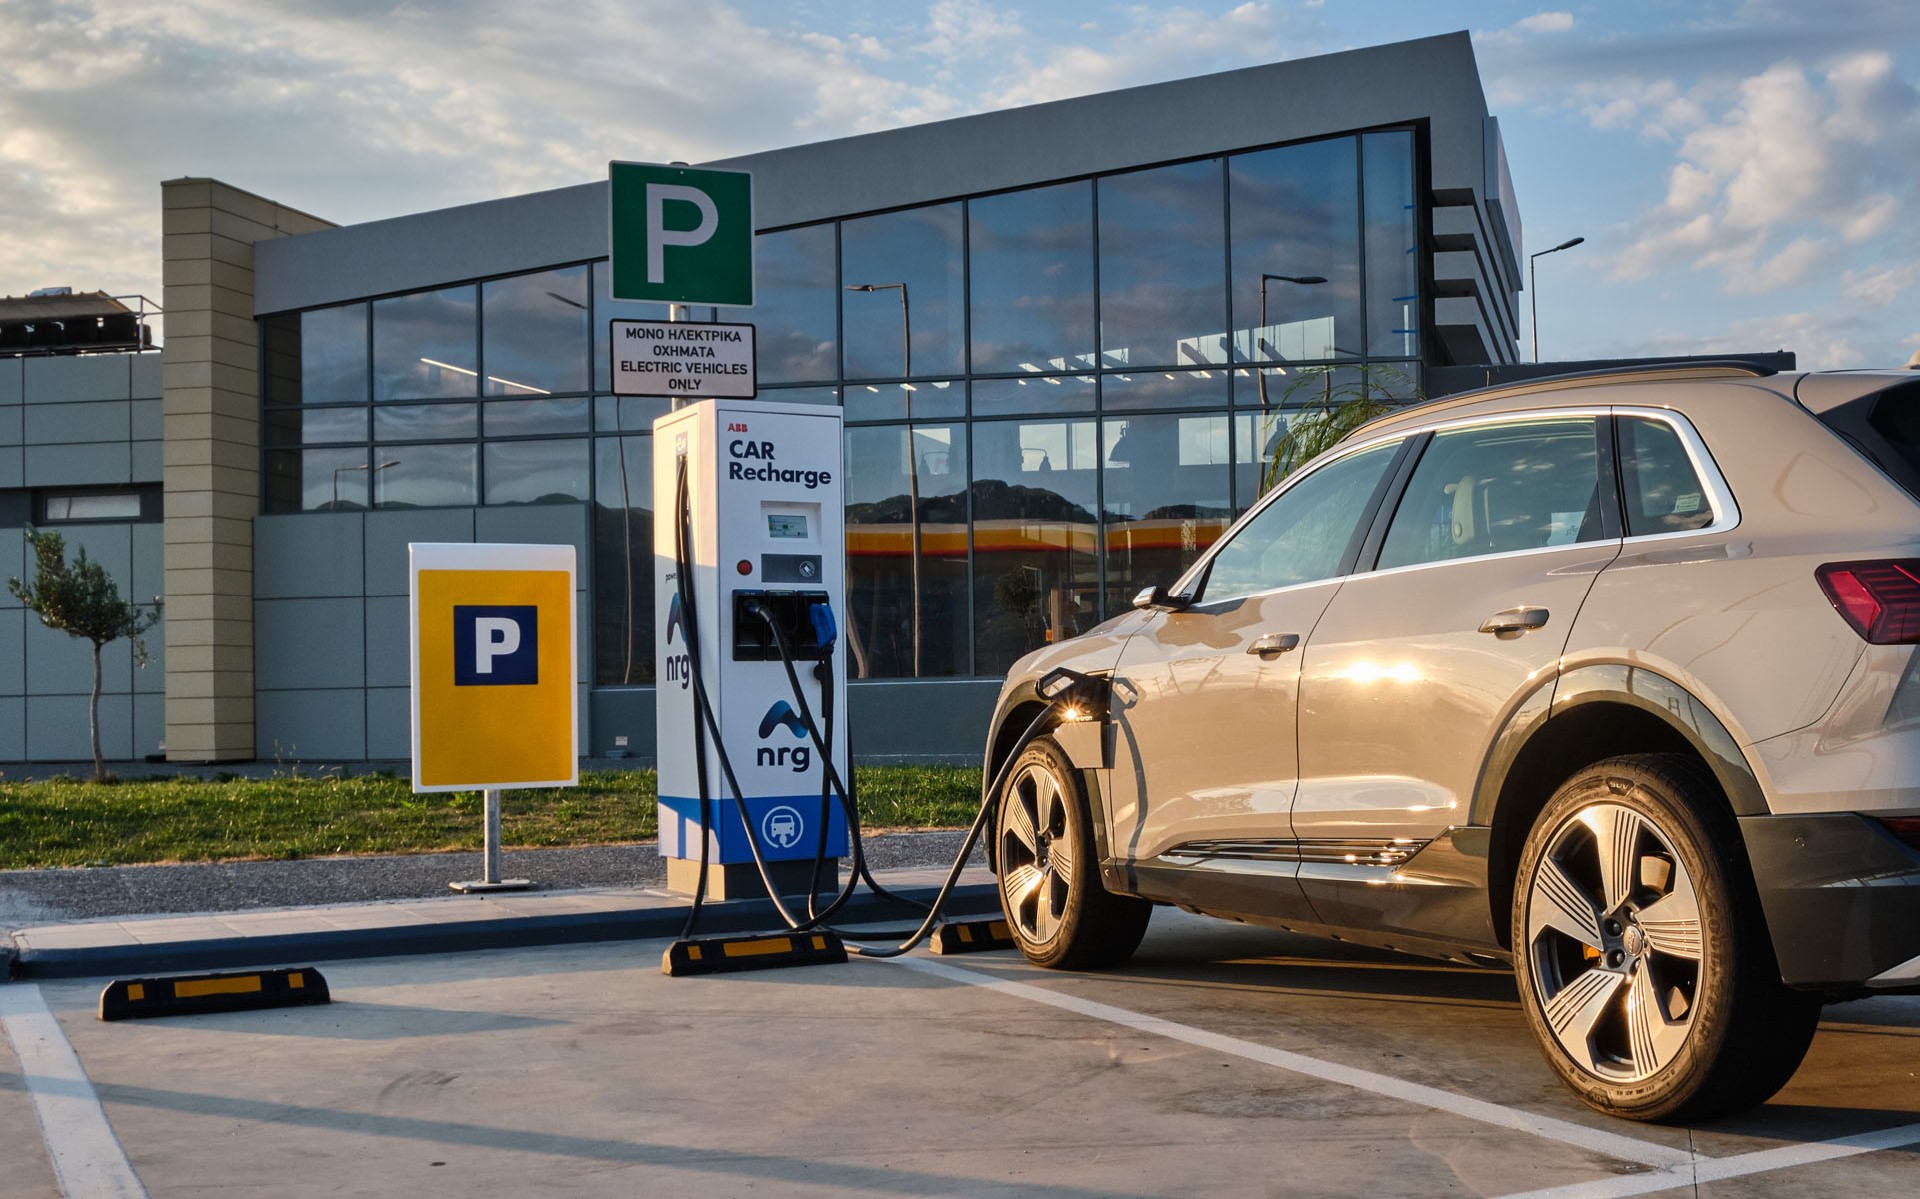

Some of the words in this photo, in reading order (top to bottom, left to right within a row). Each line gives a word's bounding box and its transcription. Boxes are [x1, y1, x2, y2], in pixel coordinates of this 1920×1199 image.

[646, 182, 719, 284] P
[626, 328, 664, 340] ΜΟΝΟ
[668, 329, 742, 342] ΗΛΕΚΤΡΙΚΑ
[653, 345, 715, 358] ΟΧΗΜΑΤΑ
[621, 361, 682, 374] ELECTRIC
[686, 362, 748, 375] VEHICLES
[668, 378, 702, 390] ONLY
[727, 423, 748, 433] ABB
[729, 439, 776, 460] CAR
[729, 461, 832, 489] Recharge
[475, 617, 521, 674] P
[666, 654, 690, 690] nrg
[757, 746, 810, 773] nrg
[1609, 780, 1630, 789] SUV
